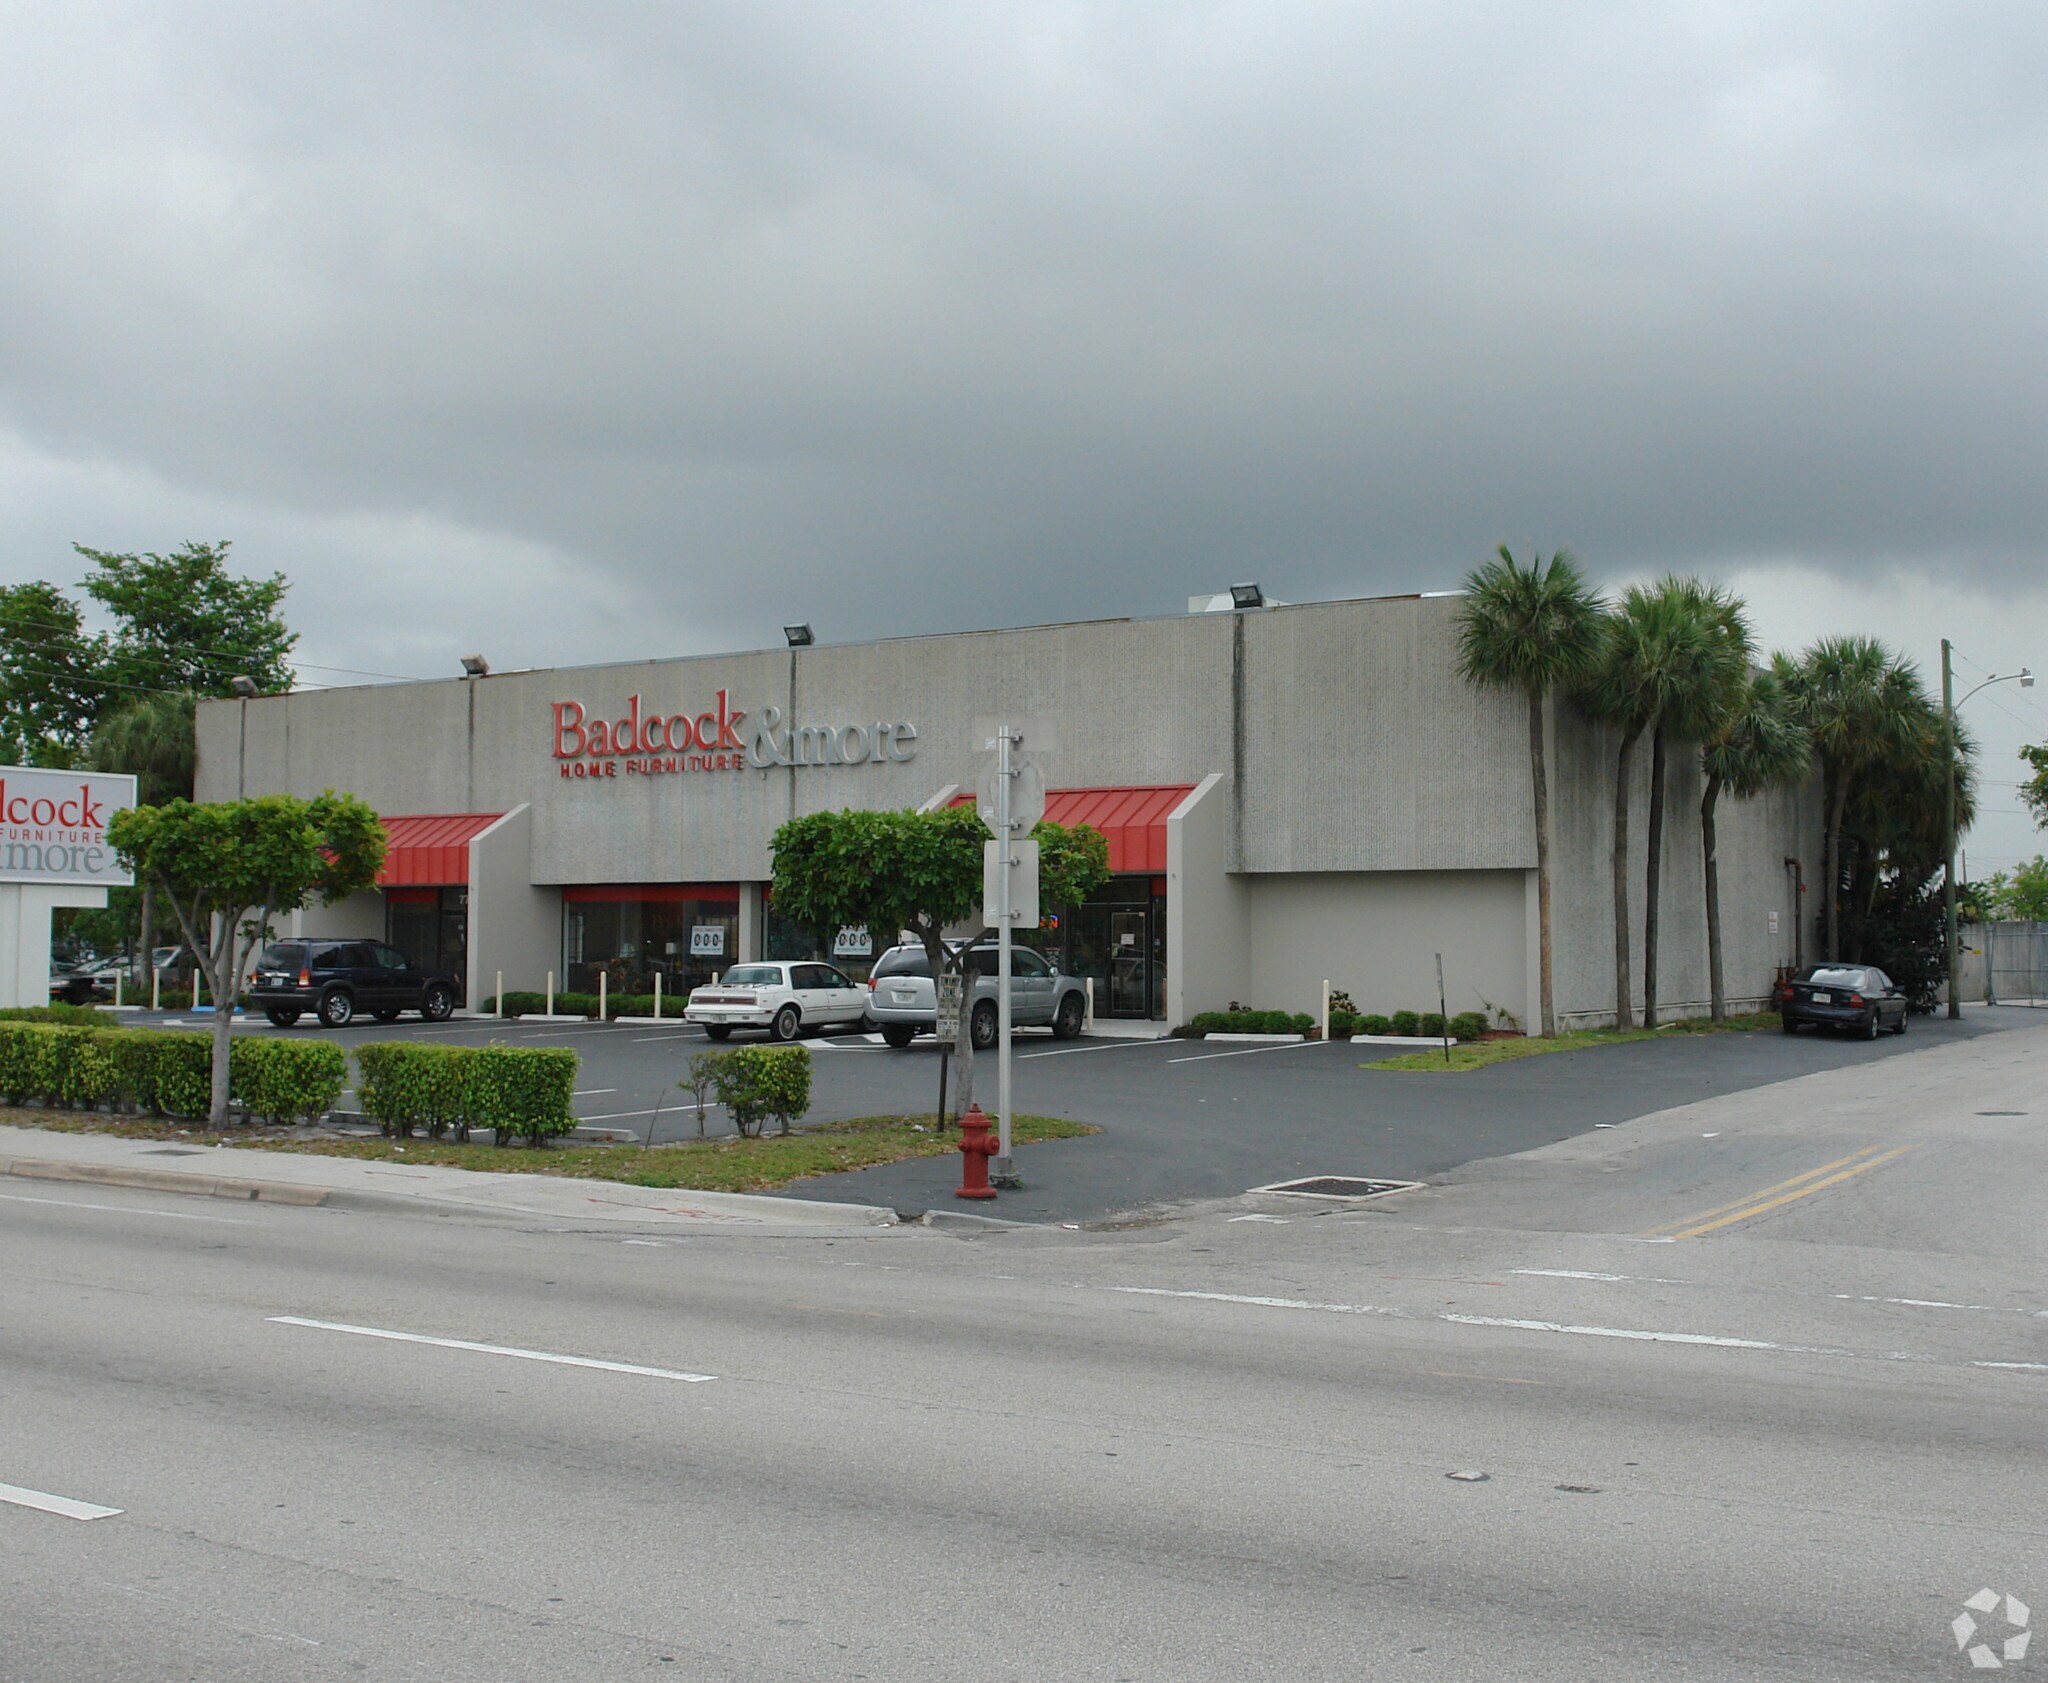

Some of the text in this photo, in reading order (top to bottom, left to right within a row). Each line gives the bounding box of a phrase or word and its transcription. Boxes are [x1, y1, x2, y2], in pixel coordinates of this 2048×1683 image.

[551, 688, 747, 759] Badcock
[560, 753, 746, 779] HOME FURNITURE
